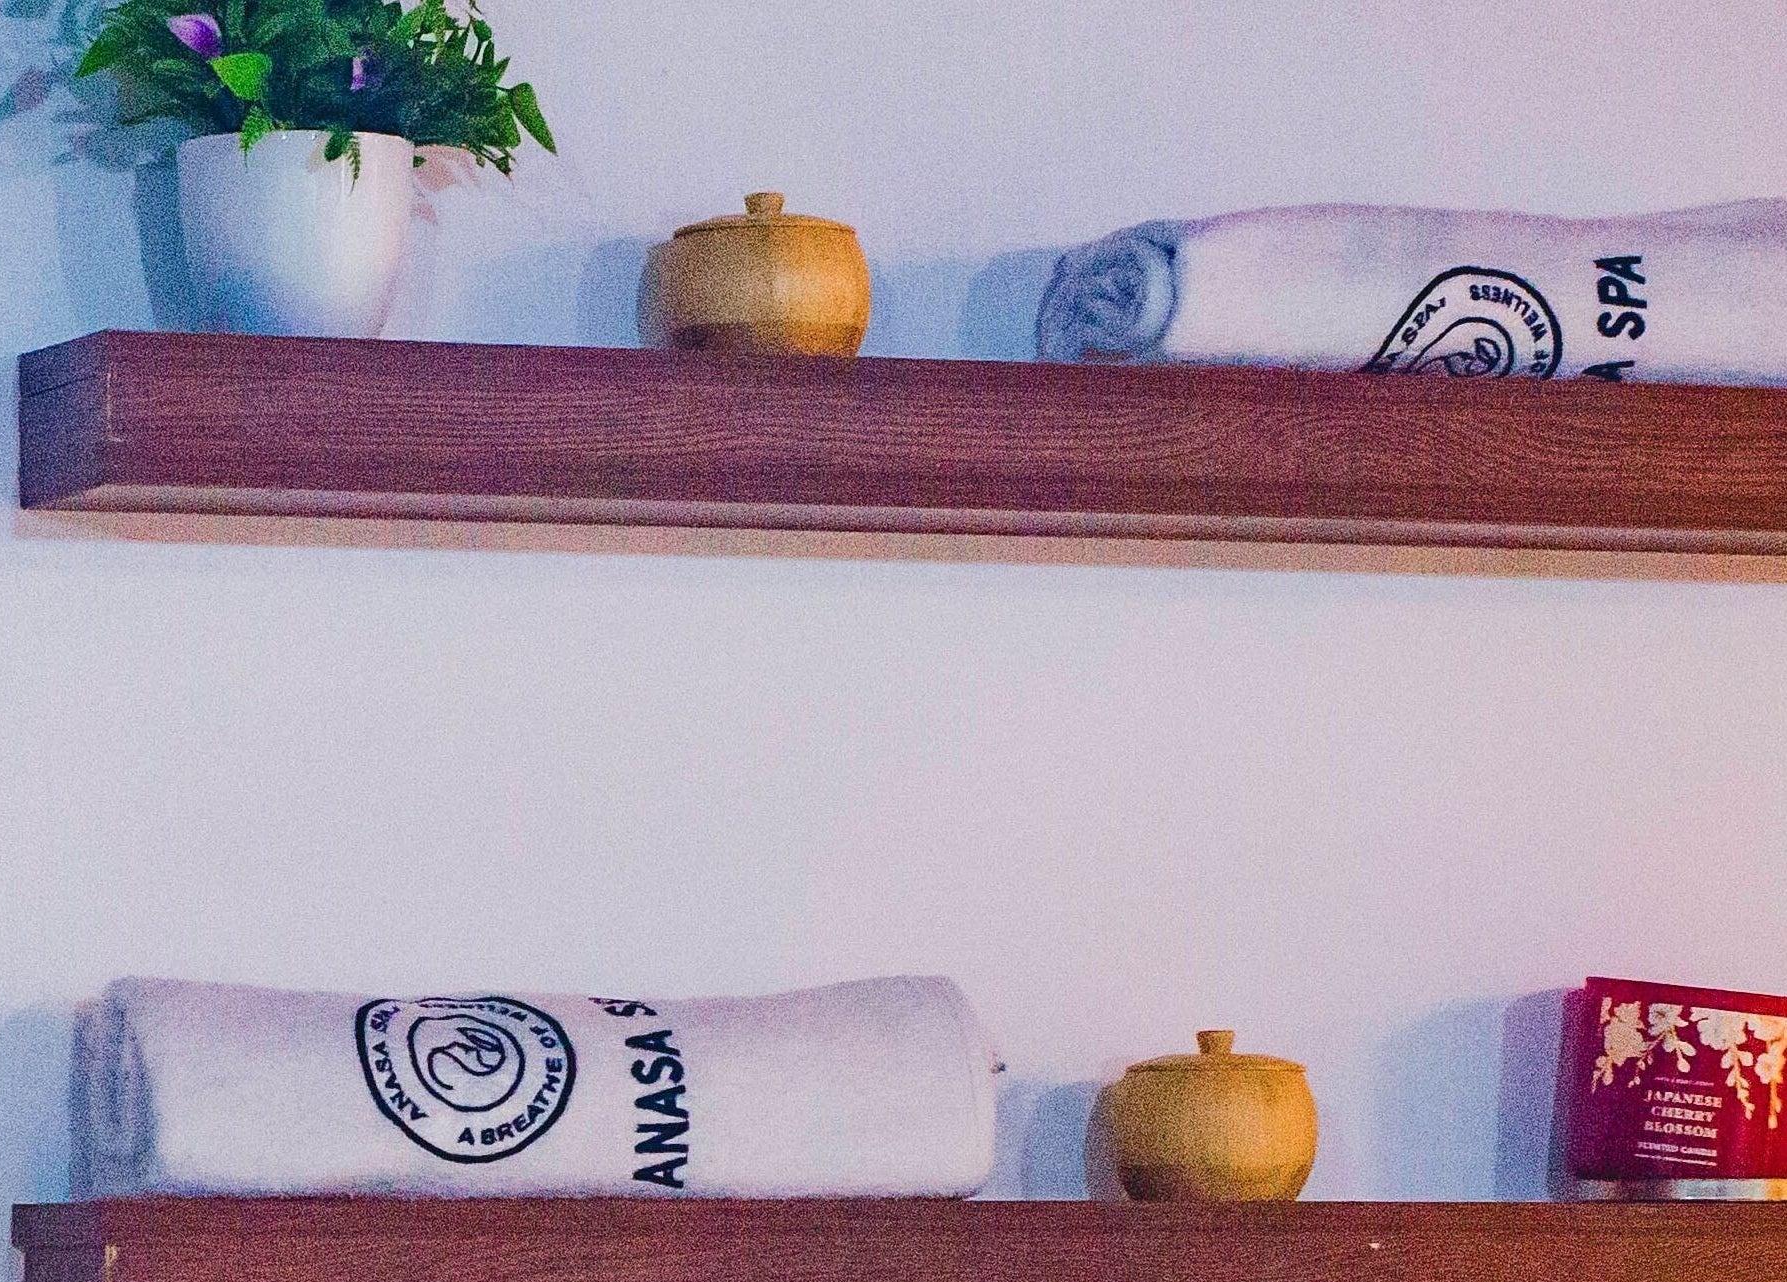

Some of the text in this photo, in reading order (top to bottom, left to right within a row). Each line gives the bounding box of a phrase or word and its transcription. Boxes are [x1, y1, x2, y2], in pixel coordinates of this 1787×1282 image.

[1469, 285, 1548, 343] WELLNESS
[1593, 255, 1647, 340] SPA
[480, 1057, 563, 1146] BREATHE
[624, 1029, 690, 1190] ANASA
[1642, 1089, 1723, 1108] JAPANESE
[1651, 1106, 1716, 1122] CHERRY
[1643, 1120, 1719, 1138] BLOSSOM
